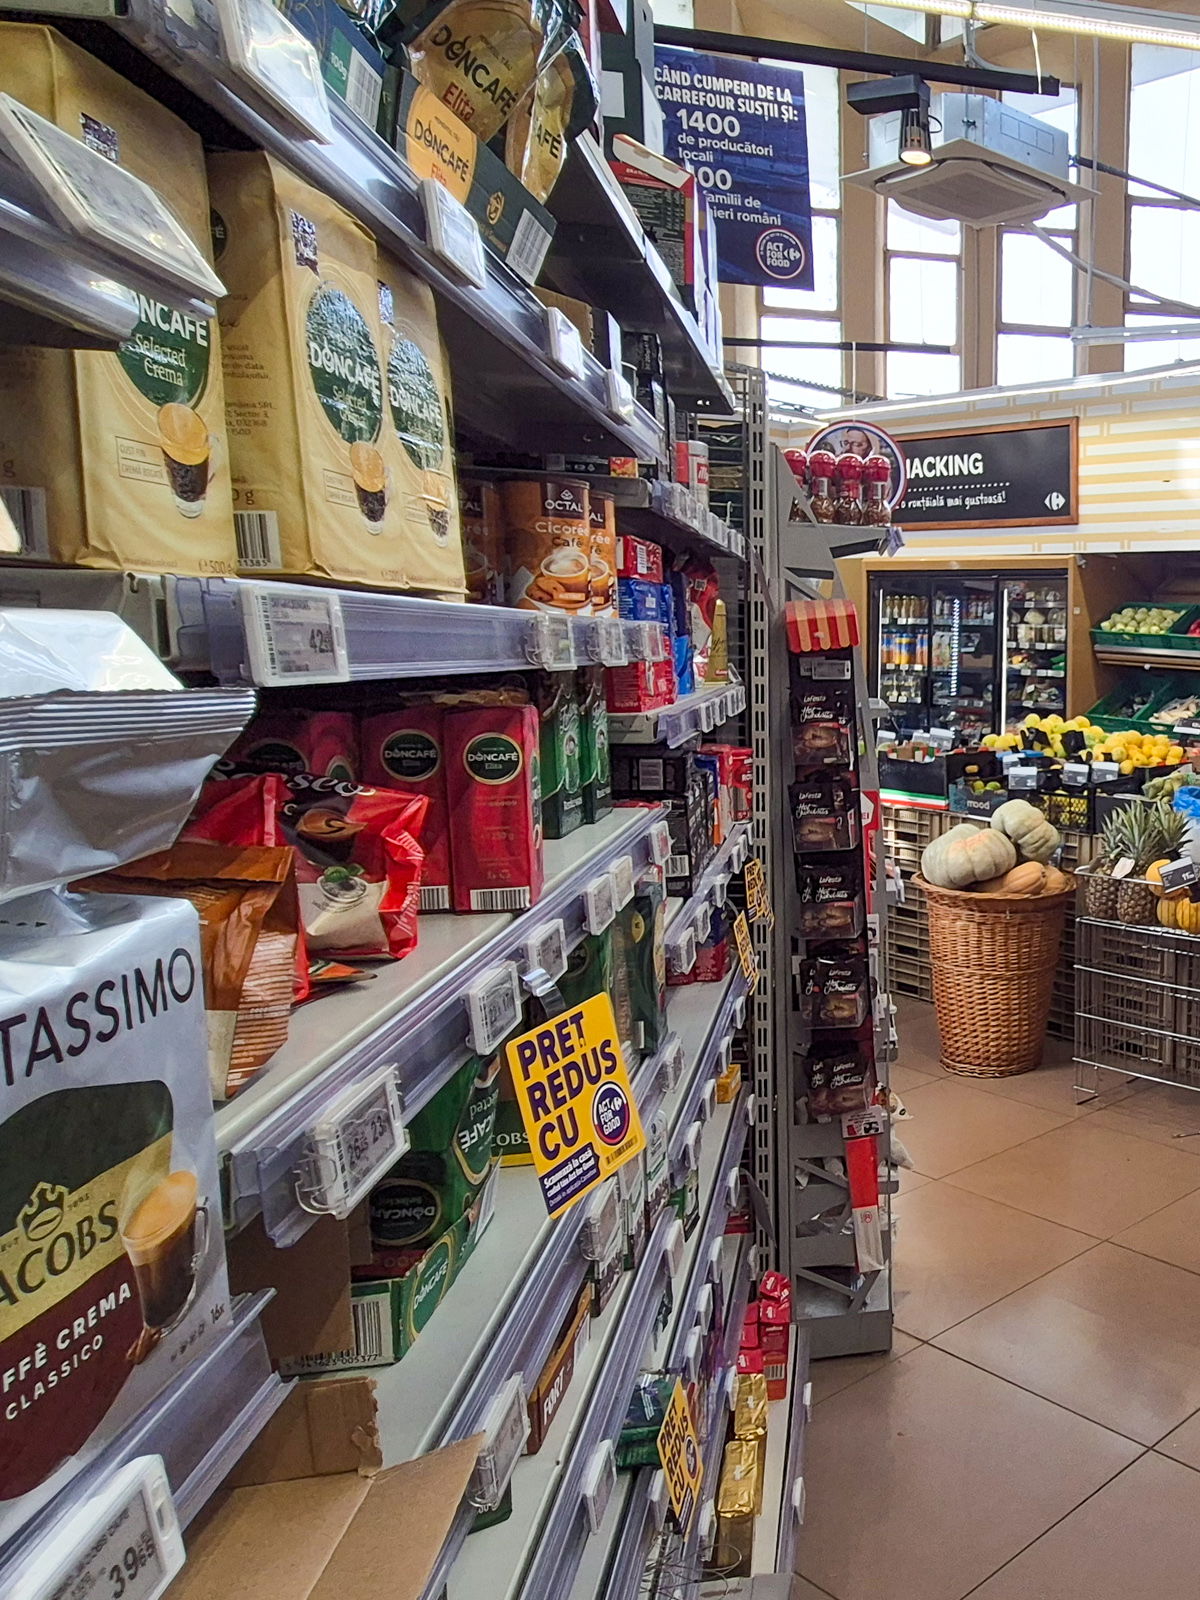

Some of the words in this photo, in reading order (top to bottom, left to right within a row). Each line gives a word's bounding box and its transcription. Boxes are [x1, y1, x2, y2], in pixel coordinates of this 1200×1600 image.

[653, 65, 691, 86] CÂND
[694, 73, 754, 97] CUMPERI
[757, 84, 775, 99] DE
[776, 87, 792, 103] LA
[442, 82, 476, 123] Elita
[655, 84, 735, 111] CARREFOUR
[676, 109, 740, 137] 1400
[677, 133, 695, 145] de
[698, 134, 773, 157] producători
[679, 147, 714, 163] locali
[697, 166, 732, 190] 00
[744, 195, 762, 209] de
[737, 210, 782, 226] români
[766, 242, 784, 251] ACT
[767, 258, 790, 268] FOOD
[907, 452, 983, 479] ACKING
[545, 500, 583, 514] OCTAL
[946, 494, 963, 507] mai
[552, 536, 583, 549] Café
[467, 749, 518, 763] DONCAFÉ
[967, 800, 990, 811] mood
[0, 947, 195, 1086] TASSIMO
[516, 1011, 586, 1081] PREȚ
[526, 1039, 617, 1123] REDUS
[598, 1098, 611, 1114] ACT
[600, 1109, 614, 1125] FOR
[539, 1107, 579, 1161] CU
[603, 1116, 621, 1135] GOOD
[491, 1132, 530, 1146] COBS
[0, 1199, 119, 1306] ACOBS
[2, 1342, 49, 1393] FFÈ
[56, 1282, 132, 1351] CREMA
[5, 1334, 103, 1421] CLASSICO
[666, 1407, 688, 1483] REDUS
[674, 1465, 684, 1505] CU
